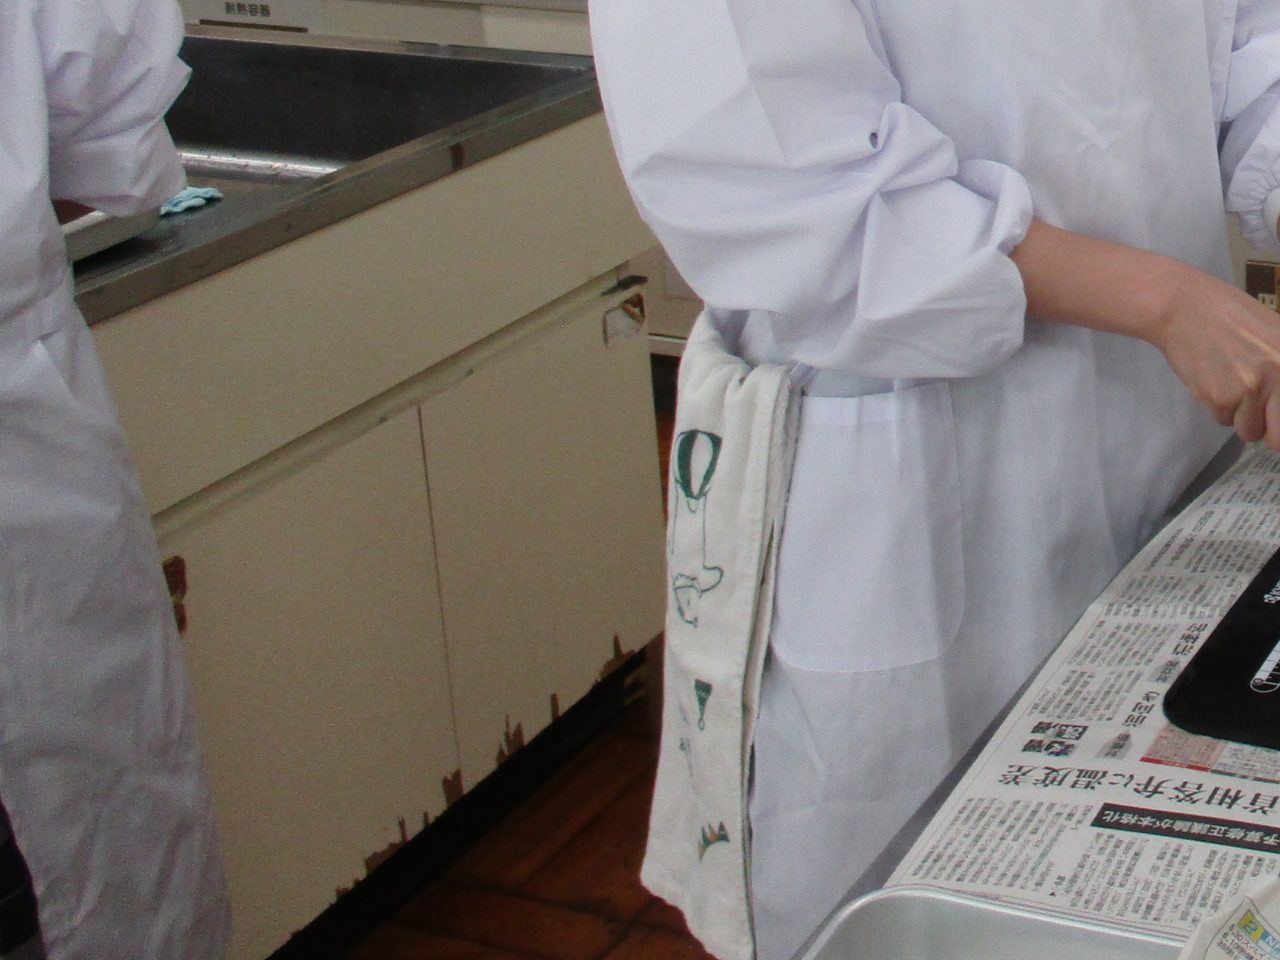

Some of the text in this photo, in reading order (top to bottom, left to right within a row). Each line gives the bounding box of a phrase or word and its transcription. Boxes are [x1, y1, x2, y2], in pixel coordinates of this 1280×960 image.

[1122, 690, 1160, 728] 前向き
[997, 763, 1280, 816] 首相答弁に温度差
